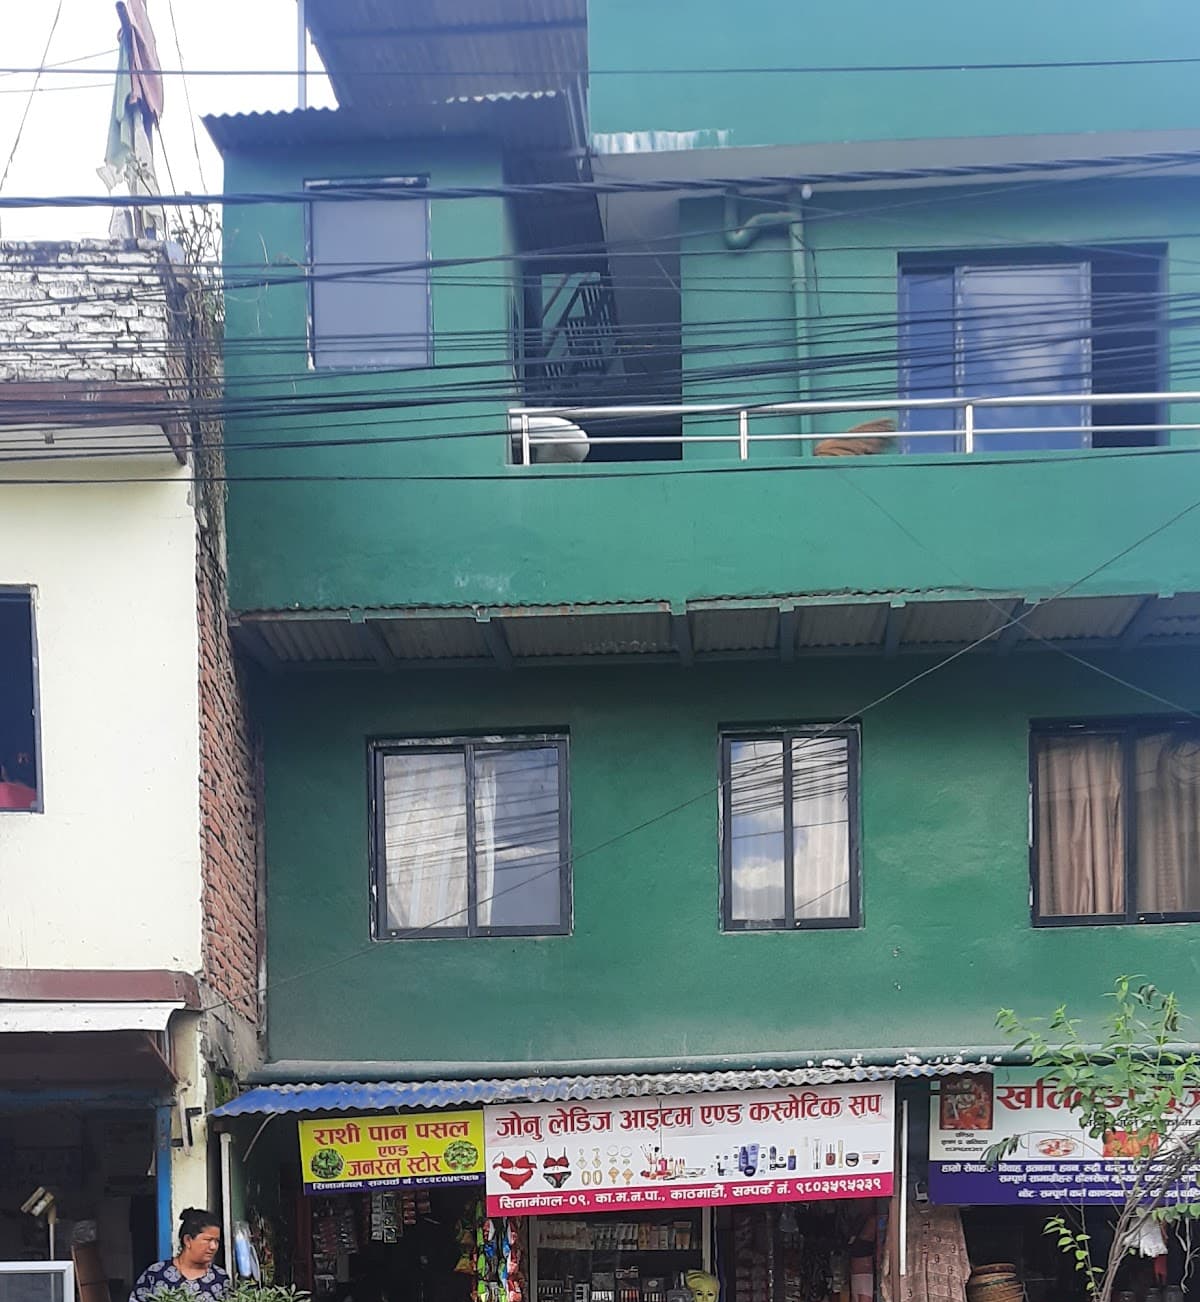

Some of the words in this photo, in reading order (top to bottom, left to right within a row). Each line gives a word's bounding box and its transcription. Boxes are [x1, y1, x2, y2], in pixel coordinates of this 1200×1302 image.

[496, 1111, 541, 1141] जोनु
[548, 1107, 612, 1134] लेडिज
[619, 1107, 693, 1130] आइटम
[701, 1104, 742, 1125] एण्ड
[749, 1092, 842, 1122] कस्मेटिक
[848, 1094, 882, 1116] सप
[313, 1123, 361, 1145] राशी
[368, 1124, 408, 1142] पान
[415, 1121, 470, 1139] पसल
[378, 1145, 409, 1158] एण्ड
[346, 1159, 400, 1177] जनरल
[406, 1152, 442, 1174] स्टोर
[732, 1182, 774, 1197] सम्पर्क
[776, 1181, 791, 1194] नं.
